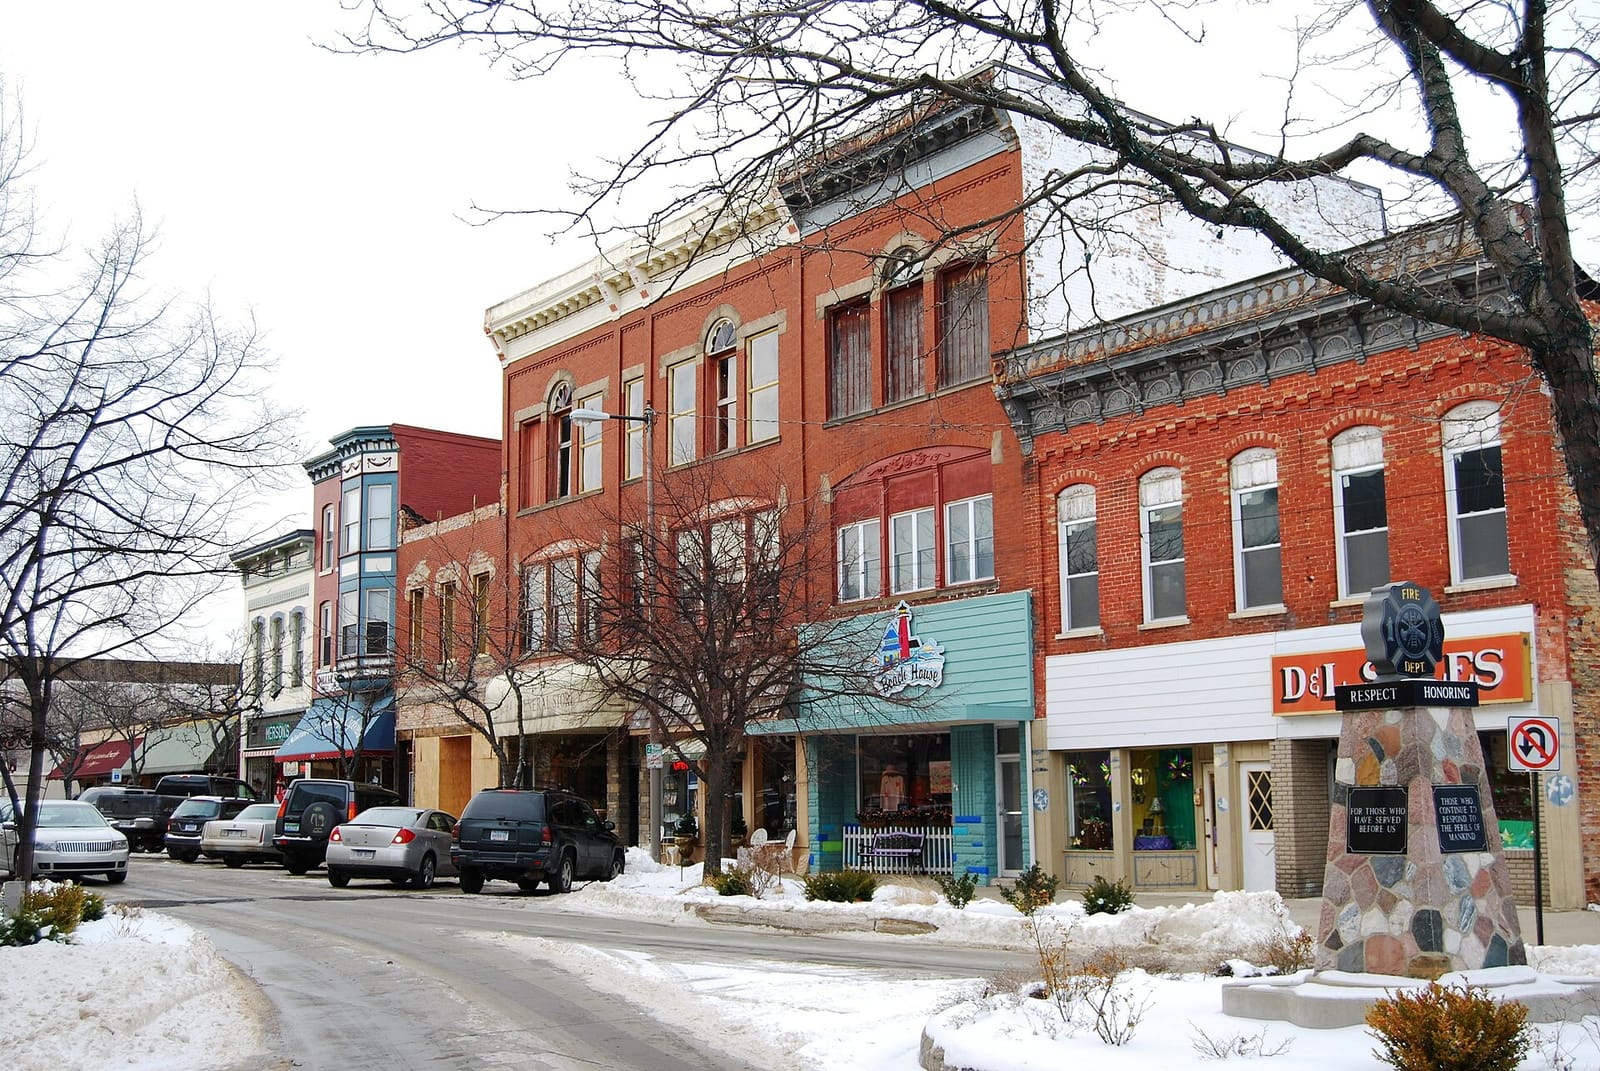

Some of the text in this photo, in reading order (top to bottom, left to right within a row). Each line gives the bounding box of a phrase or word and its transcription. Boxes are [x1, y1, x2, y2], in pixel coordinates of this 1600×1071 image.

[1401, 588, 1421, 601] FIRE
[880, 663, 939, 692] Beach House
[1281, 662, 1338, 703] D&L
[1350, 687, 1398, 703] RESPECT
[1423, 685, 1471, 700] HONORING
[1440, 797, 1474, 806] THOSE WHO
[1350, 807, 1406, 815] FOR THOSE WHO
[1439, 805, 1478, 814] CONTINUE TO
[1354, 816, 1401, 824] HAVE SERVED
[1442, 814, 1477, 824] RESPOND TO
[1359, 825, 1397, 833] BEFORE US
[1440, 823, 1481, 832] THE PERILS OF
[1448, 832, 1476, 841] MANKIND
